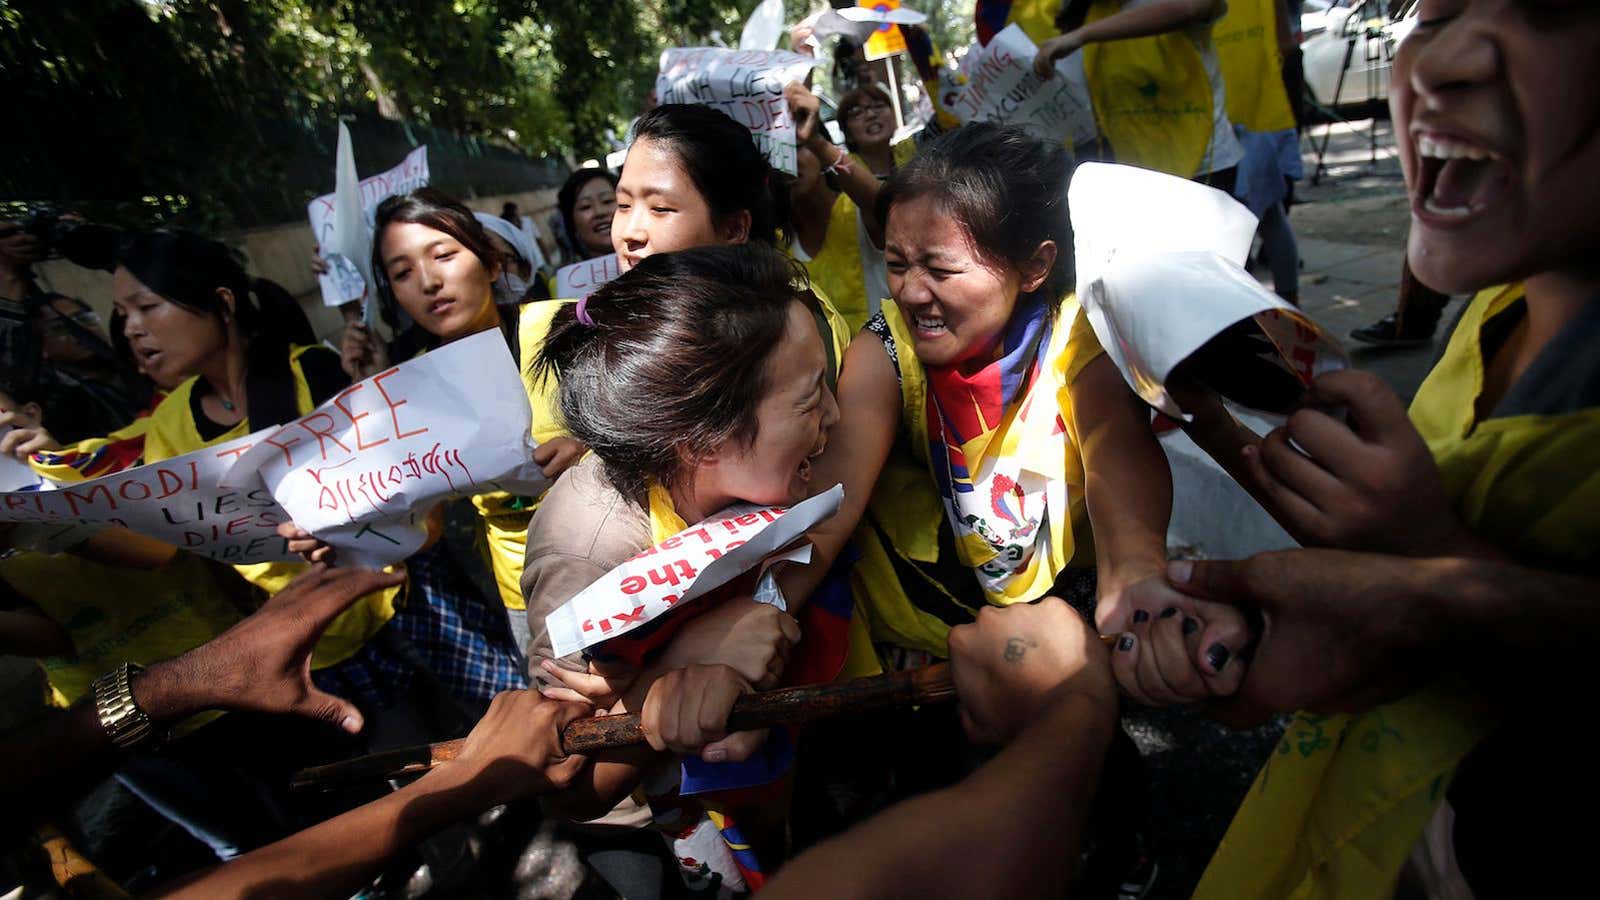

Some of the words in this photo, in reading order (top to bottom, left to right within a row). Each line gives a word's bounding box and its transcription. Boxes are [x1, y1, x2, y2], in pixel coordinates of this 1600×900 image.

[742, 97, 791, 131] DIE
[265, 367, 429, 467] FREE
[161, 489, 276, 525] LIES
[183, 511, 280, 547] DIES
[619, 559, 698, 595] the
